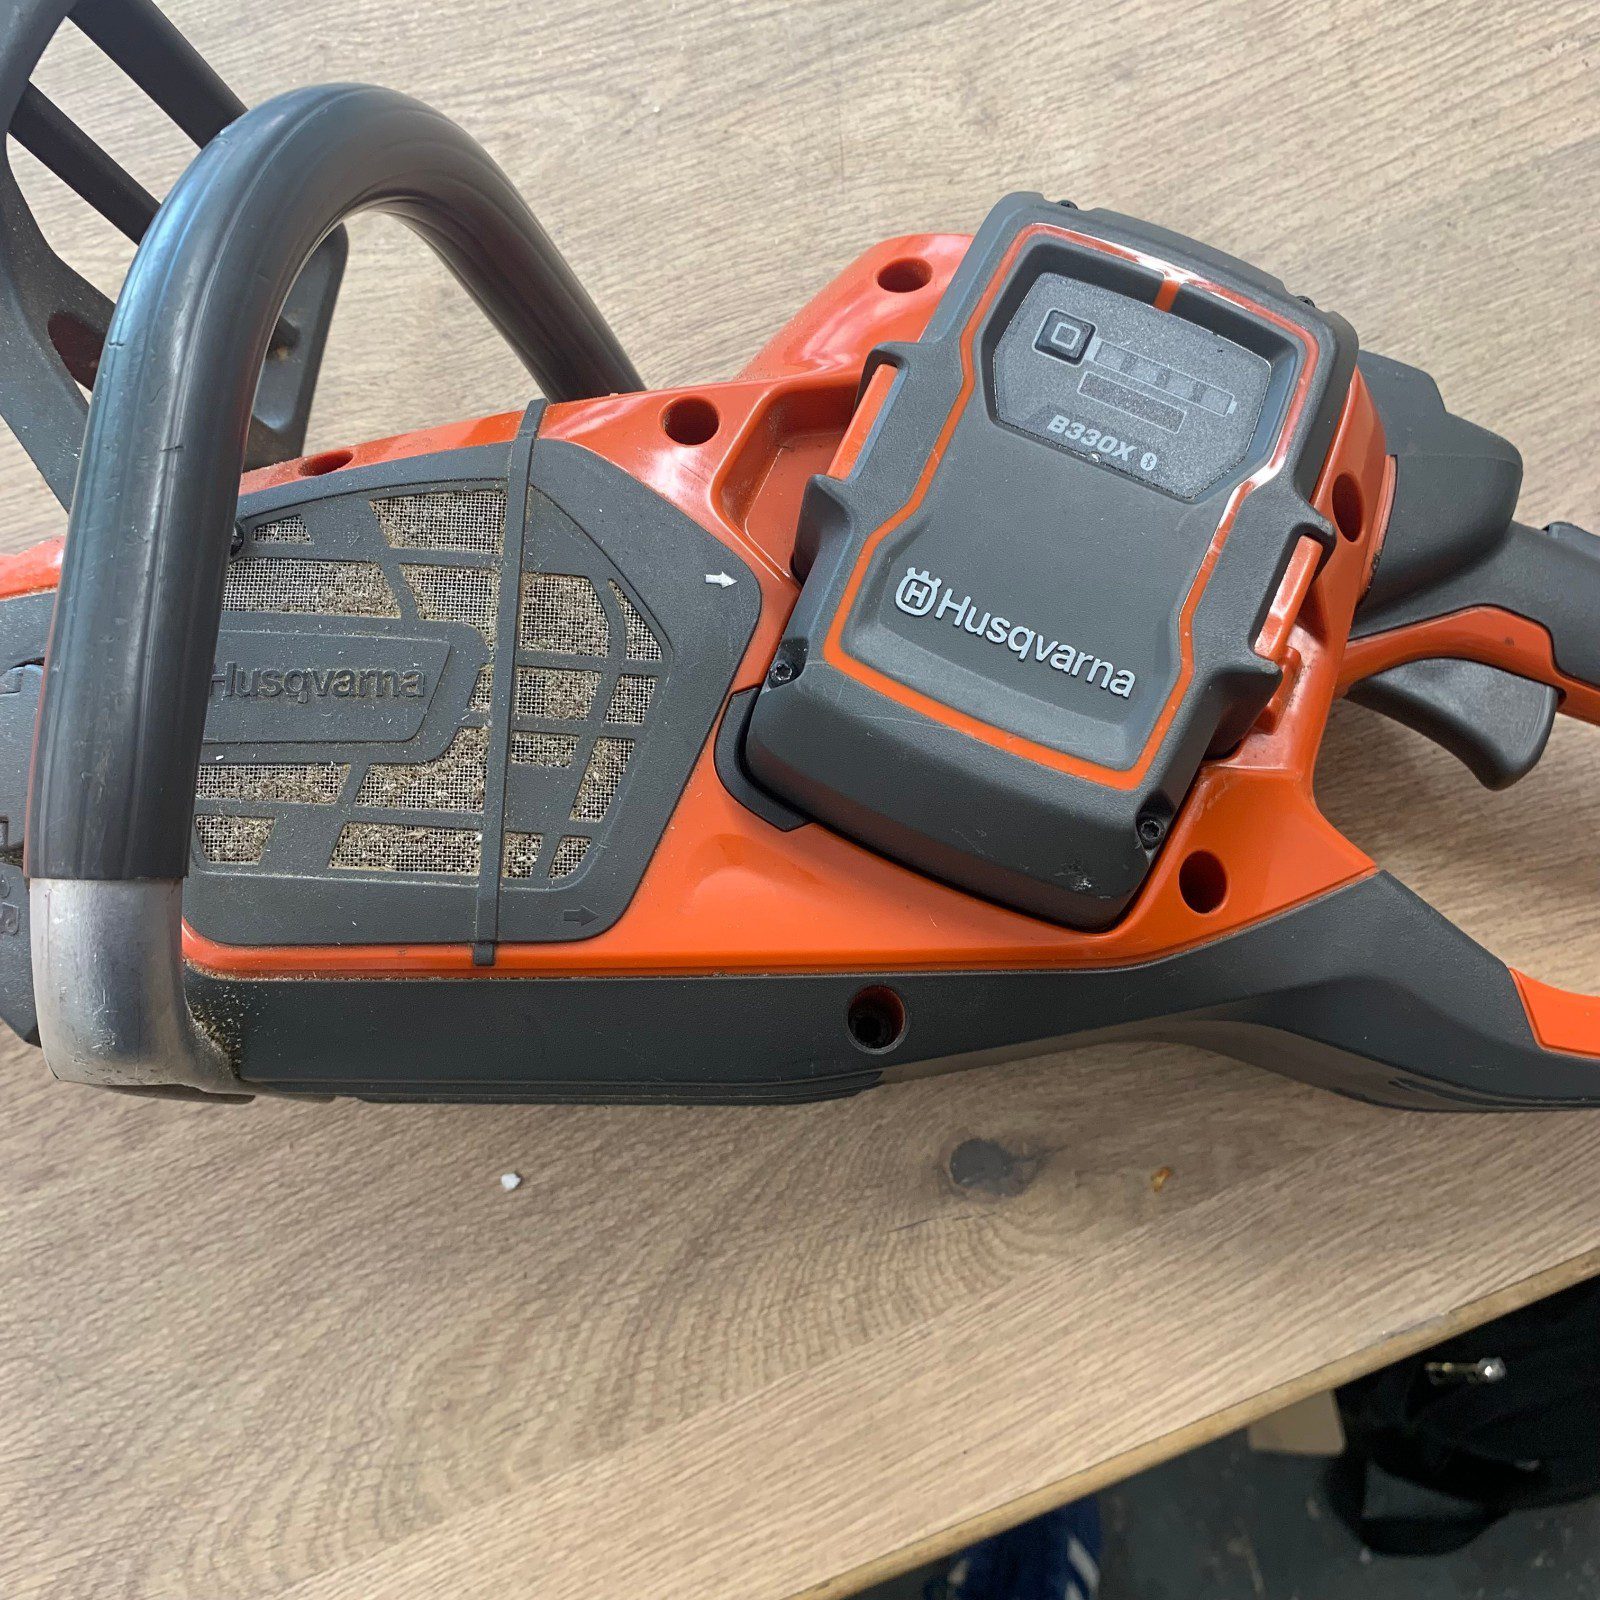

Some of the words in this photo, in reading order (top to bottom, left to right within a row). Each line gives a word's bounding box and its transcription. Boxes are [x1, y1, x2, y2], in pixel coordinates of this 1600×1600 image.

[1046, 414, 1138, 461] B330X
[934, 588, 1137, 699] Husqvarna
[210, 661, 425, 704] Husqvarna
